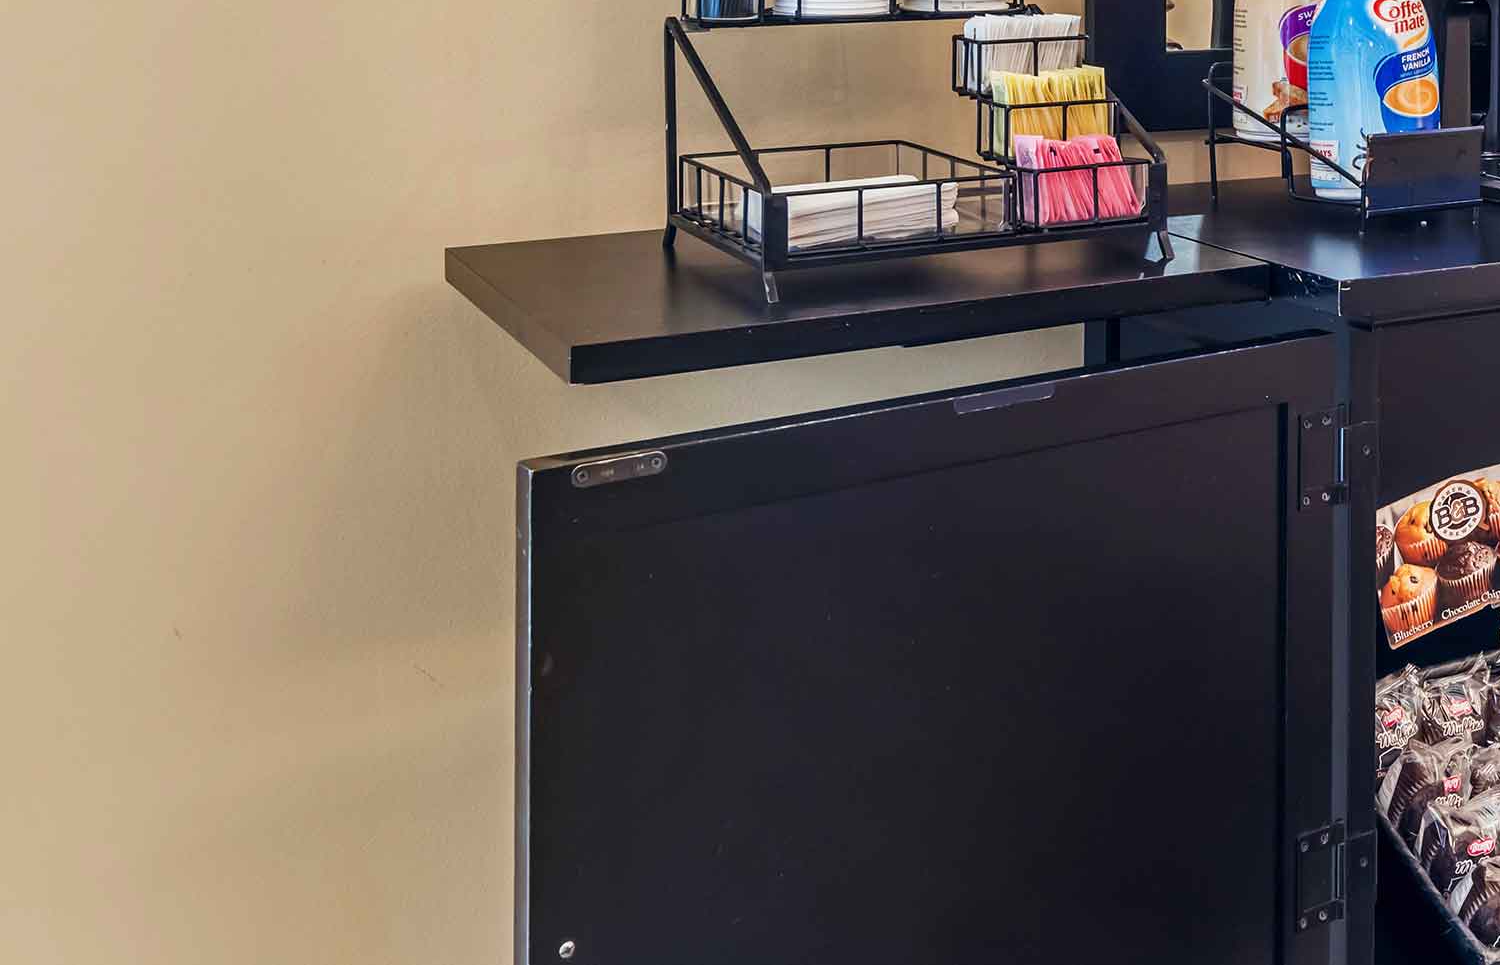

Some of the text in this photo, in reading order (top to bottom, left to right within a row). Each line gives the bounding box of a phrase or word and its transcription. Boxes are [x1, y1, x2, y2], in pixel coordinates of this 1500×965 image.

[1394, 15, 1425, 34] mate
[1401, 46, 1431, 64] FRENCH
[1402, 55, 1432, 72] VANILLA
[1434, 496, 1480, 529] B&B
[1393, 619, 1434, 643] Blueberry
[1441, 598, 1481, 620] Chocolate
[1442, 716, 1485, 736] Muffins
